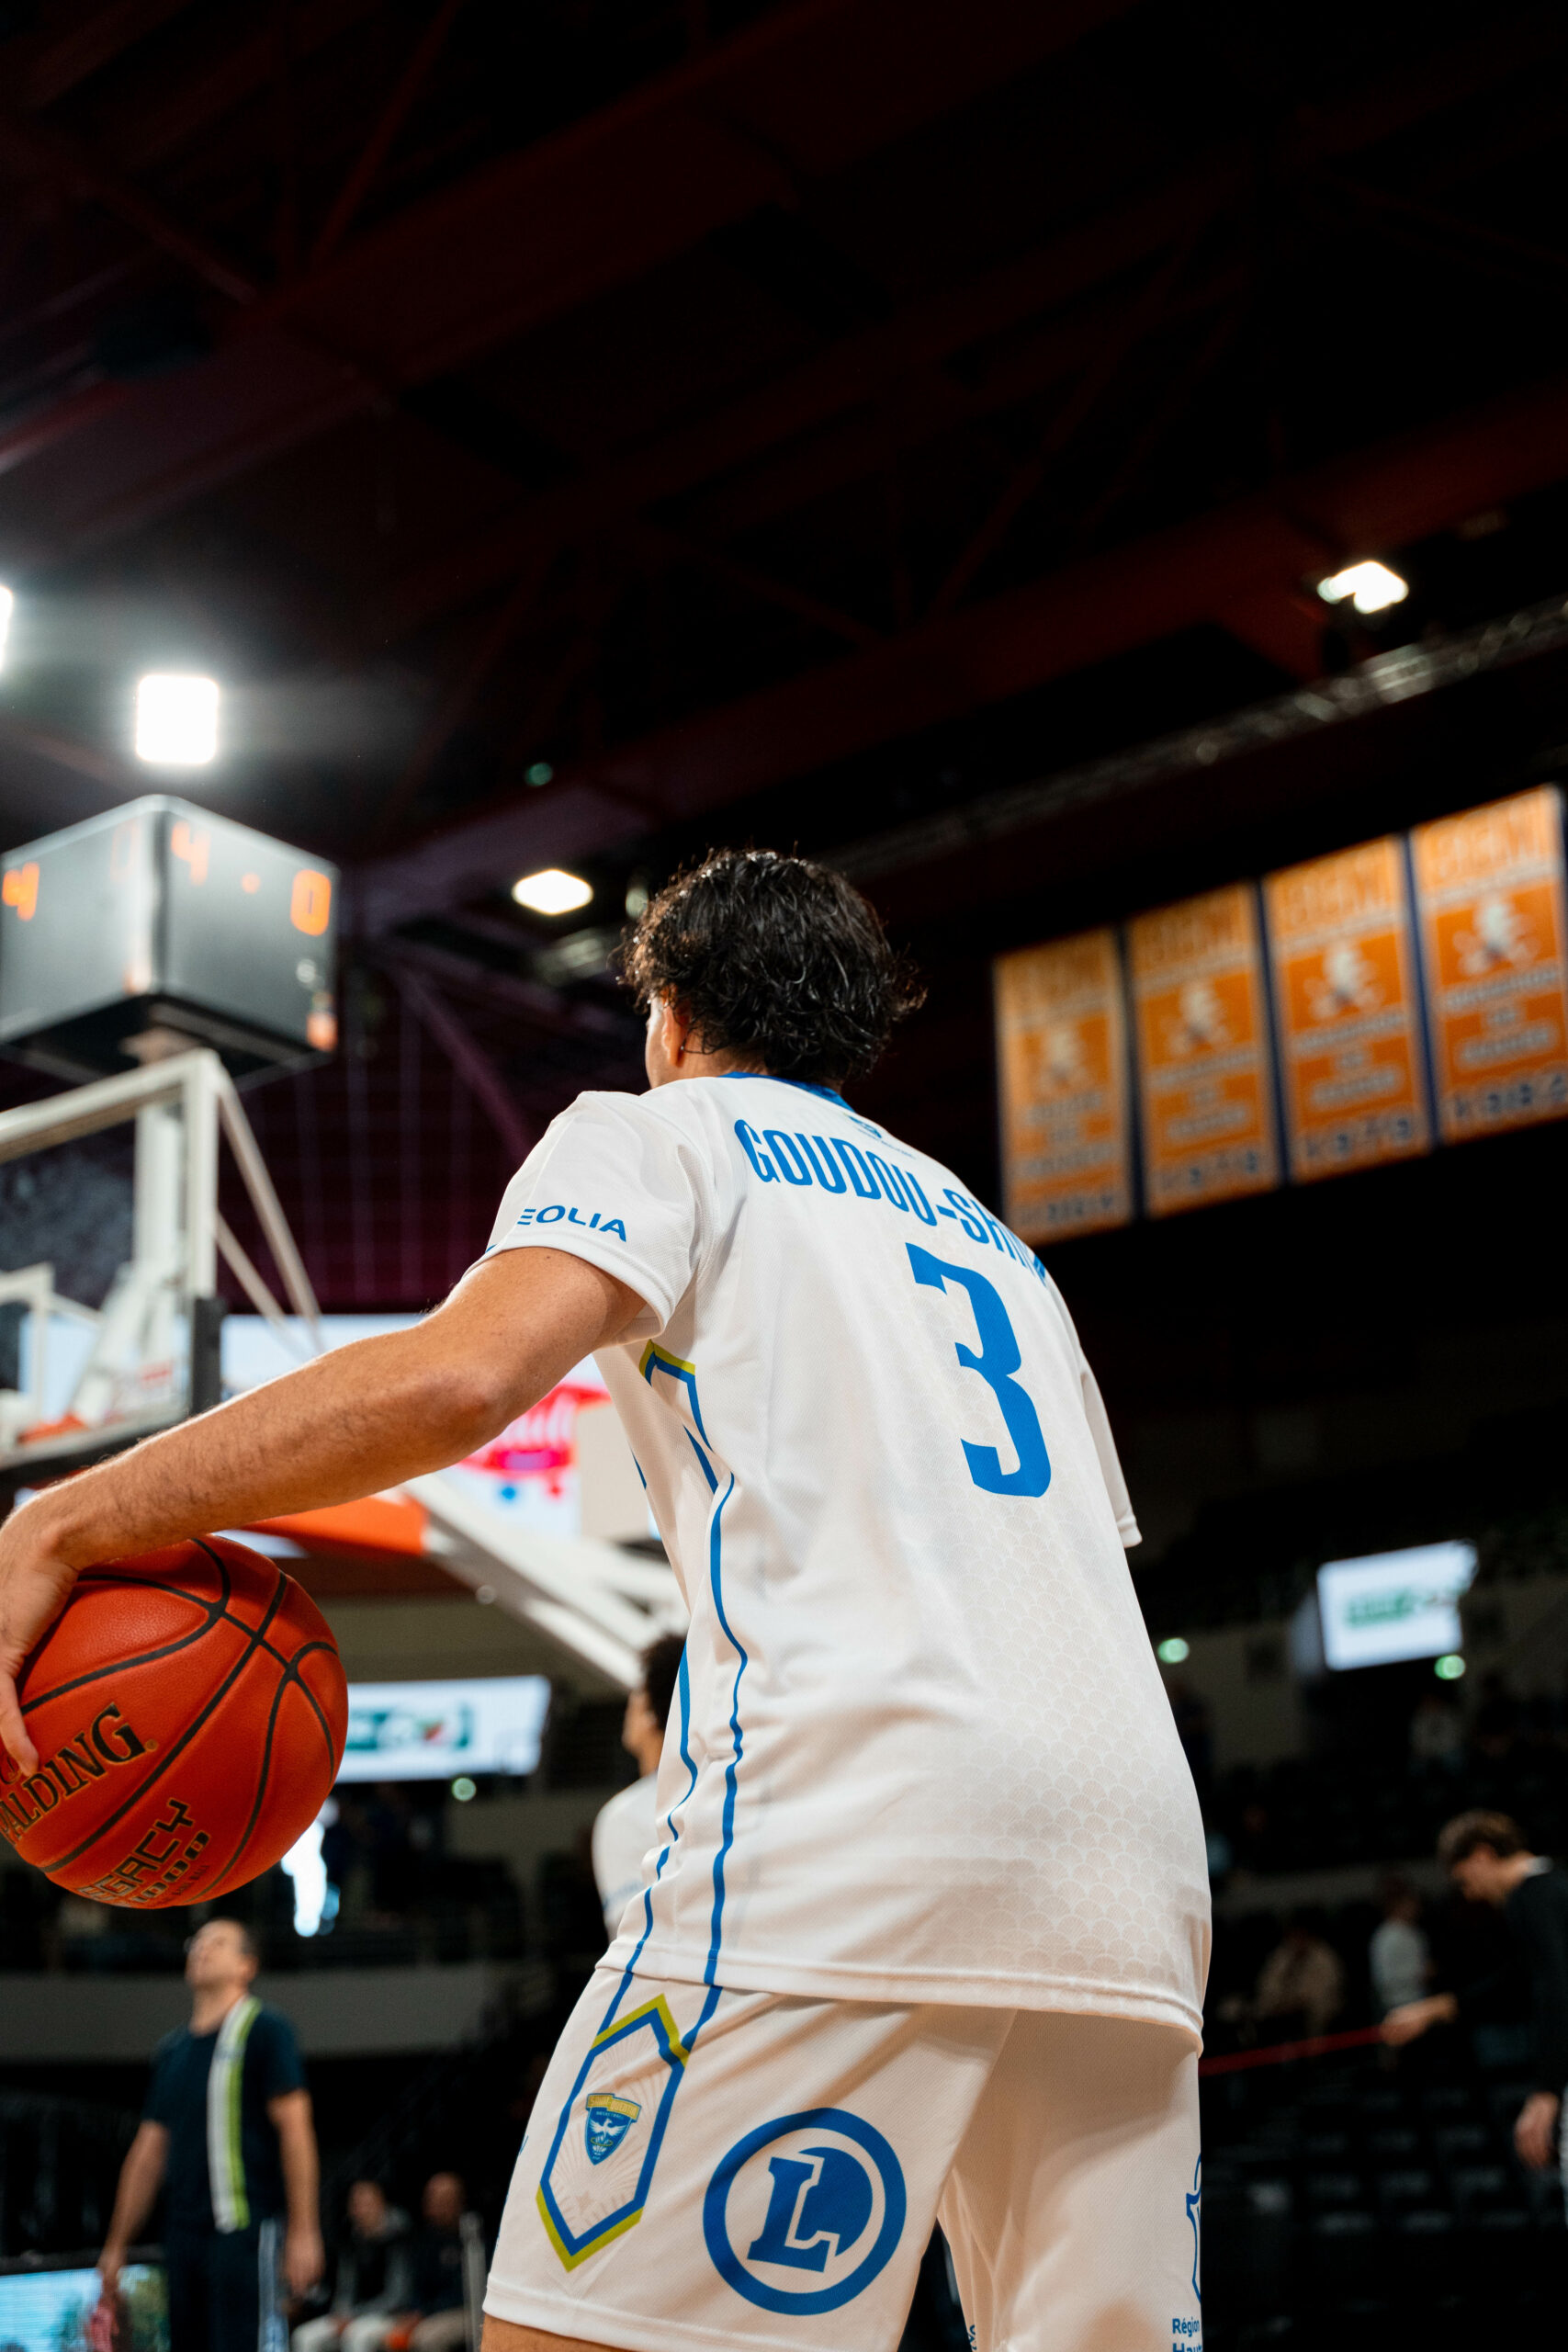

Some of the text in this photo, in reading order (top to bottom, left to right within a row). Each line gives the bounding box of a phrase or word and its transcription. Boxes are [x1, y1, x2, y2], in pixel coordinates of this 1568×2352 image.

[517, 1204, 626, 1242] EOLIA
[905, 1242, 1052, 1498] 3
[77, 1799, 194, 1908] EGACY
[747, 2156, 831, 2273] L
